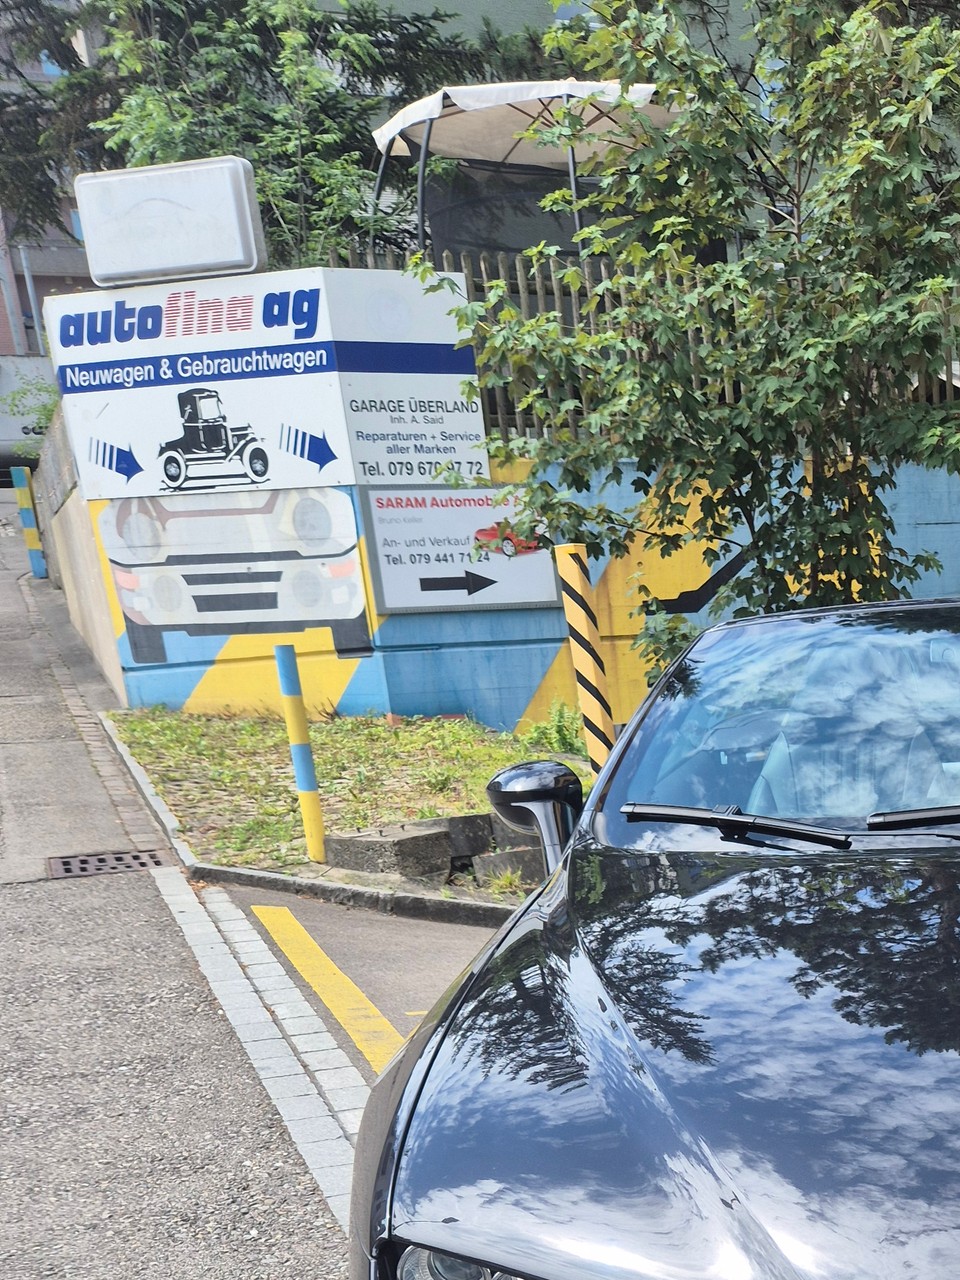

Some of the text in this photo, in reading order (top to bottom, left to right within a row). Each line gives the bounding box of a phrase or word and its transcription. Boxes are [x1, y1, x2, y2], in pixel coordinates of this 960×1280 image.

[60, 288, 321, 348] autofina ag
[66, 348, 327, 388] Neuwagen & Gebrauchtwagen
[349, 396, 479, 413] GARAGE ÜBERLAND
[390, 415, 445, 424] Inh. A. Said
[355, 431, 428, 443] Reparaturen
[440, 431, 481, 441] Service
[386, 443, 457, 454] aller Marken
[359, 461, 385, 476] Tel.
[388, 461, 414, 476] 079
[467, 461, 484, 475] 72
[376, 496, 427, 509] SARAM
[430, 495, 510, 508] Automobe
[382, 535, 470, 547] An- und Verkauf
[384, 554, 406, 565] Tel.
[410, 553, 431, 565] 079
[434, 552, 455, 564] 441
